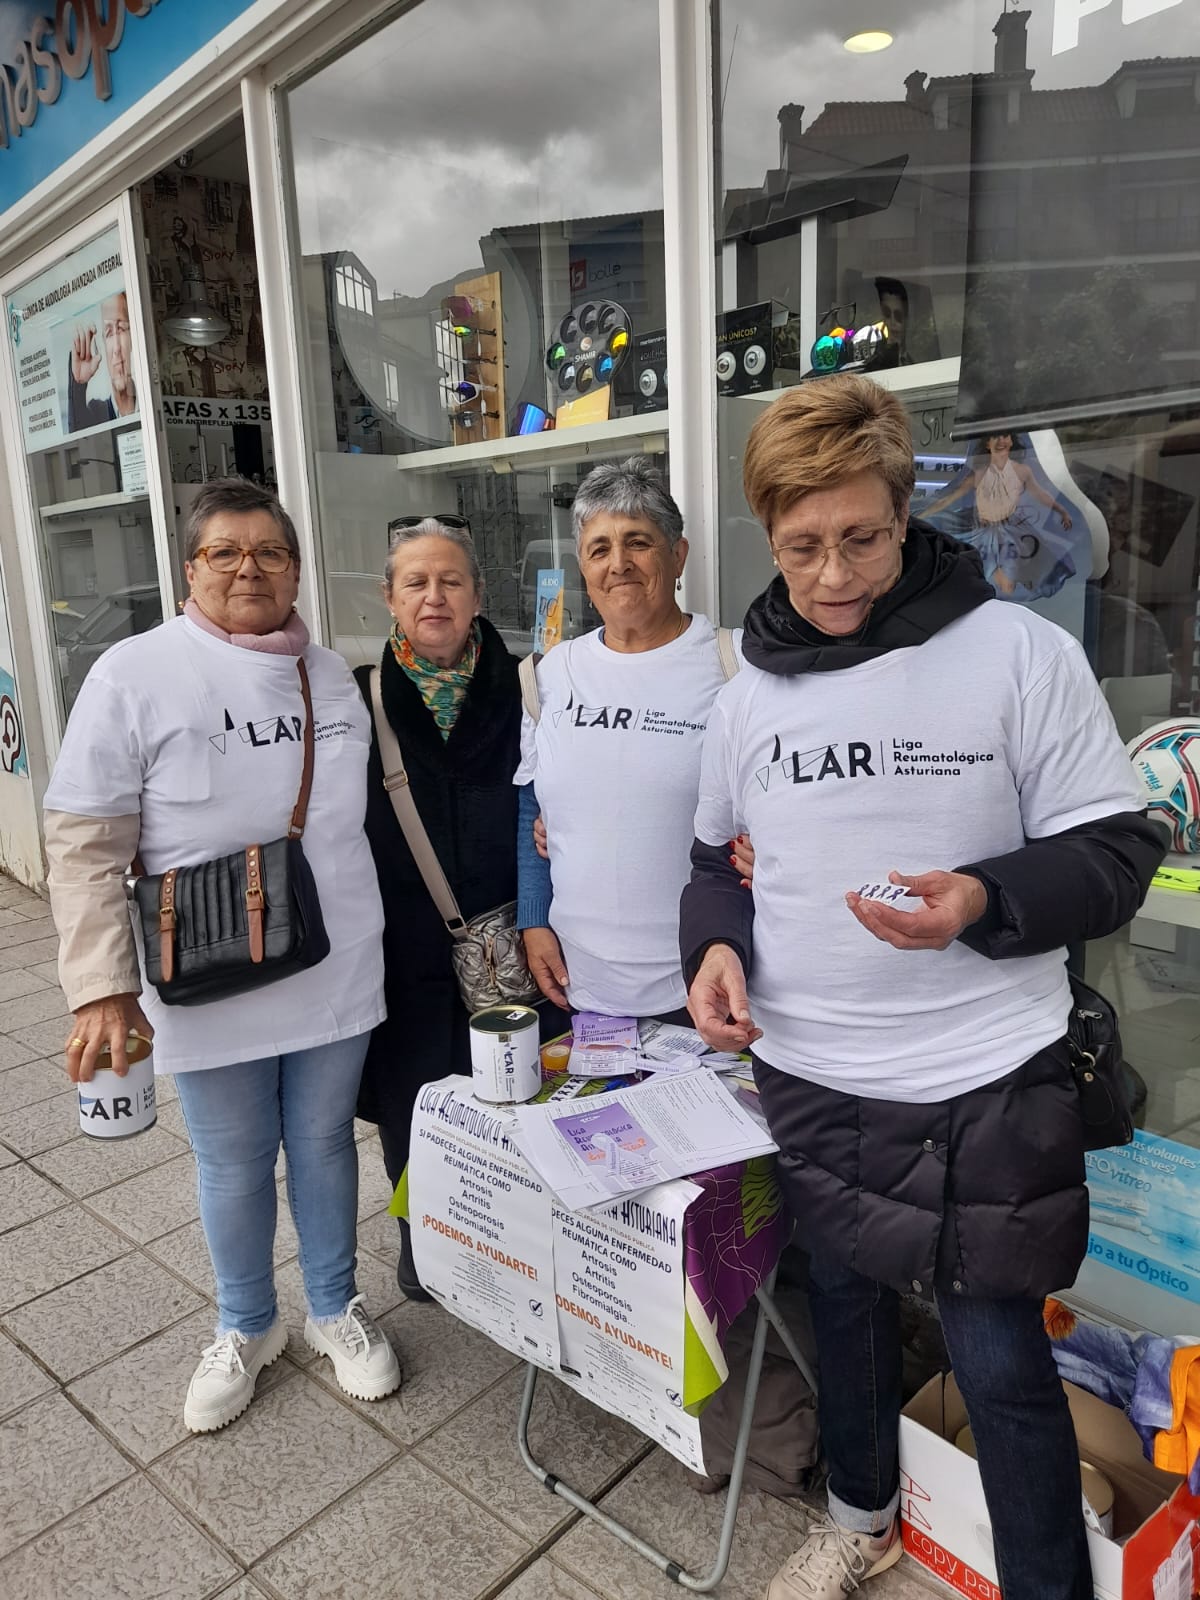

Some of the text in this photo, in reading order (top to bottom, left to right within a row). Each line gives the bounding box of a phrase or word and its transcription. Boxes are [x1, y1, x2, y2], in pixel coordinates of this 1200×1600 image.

[71, 267, 97, 295] AVANZADA
[96, 253, 123, 278] INTEGRAL
[574, 350, 597, 363] SHAMIR
[167, 417, 183, 425] CON
[575, 704, 633, 730] LAR
[646, 708, 666, 718] Liga
[641, 726, 684, 736] Asturiana
[893, 738, 923, 751] Liga
[792, 742, 876, 784] LAR
[893, 751, 994, 765] Reumatológica
[894, 765, 961, 776] Asturiana
[418, 1129, 542, 1193] SI PADECES ALGUNA ENFERMEDAD
[1133, 1153, 1149, 1166] las
[1151, 1162, 1177, 1175] ves?
[1147, 1146, 1200, 1169] volantes
[444, 1154, 511, 1192] REUMÁTICA COMO
[460, 1175, 493, 1198] Artrosis
[462, 1189, 491, 1210] Artritis
[449, 1196, 505, 1230] Osteoporosis
[621, 1199, 677, 1248] ASTURIANA
[422, 1214, 538, 1282] ¡PODEMOS AYUDARTE!
[562, 1227, 637, 1272] REUMÁTICA COMO
[576, 1221, 609, 1244] ALGUNA
[611, 1238, 672, 1274] ENFERMEDAD
[582, 1250, 618, 1276] Artrosis
[1105, 1249, 1114, 1260] a
[1117, 1251, 1133, 1269] tu
[1137, 1258, 1189, 1292] Óptico
[585, 1266, 616, 1290] Artritis
[572, 1272, 633, 1312] Osteoporosis
[604, 1322, 673, 1370] AYUDARTE!
[911, 1530, 958, 1575] copy
